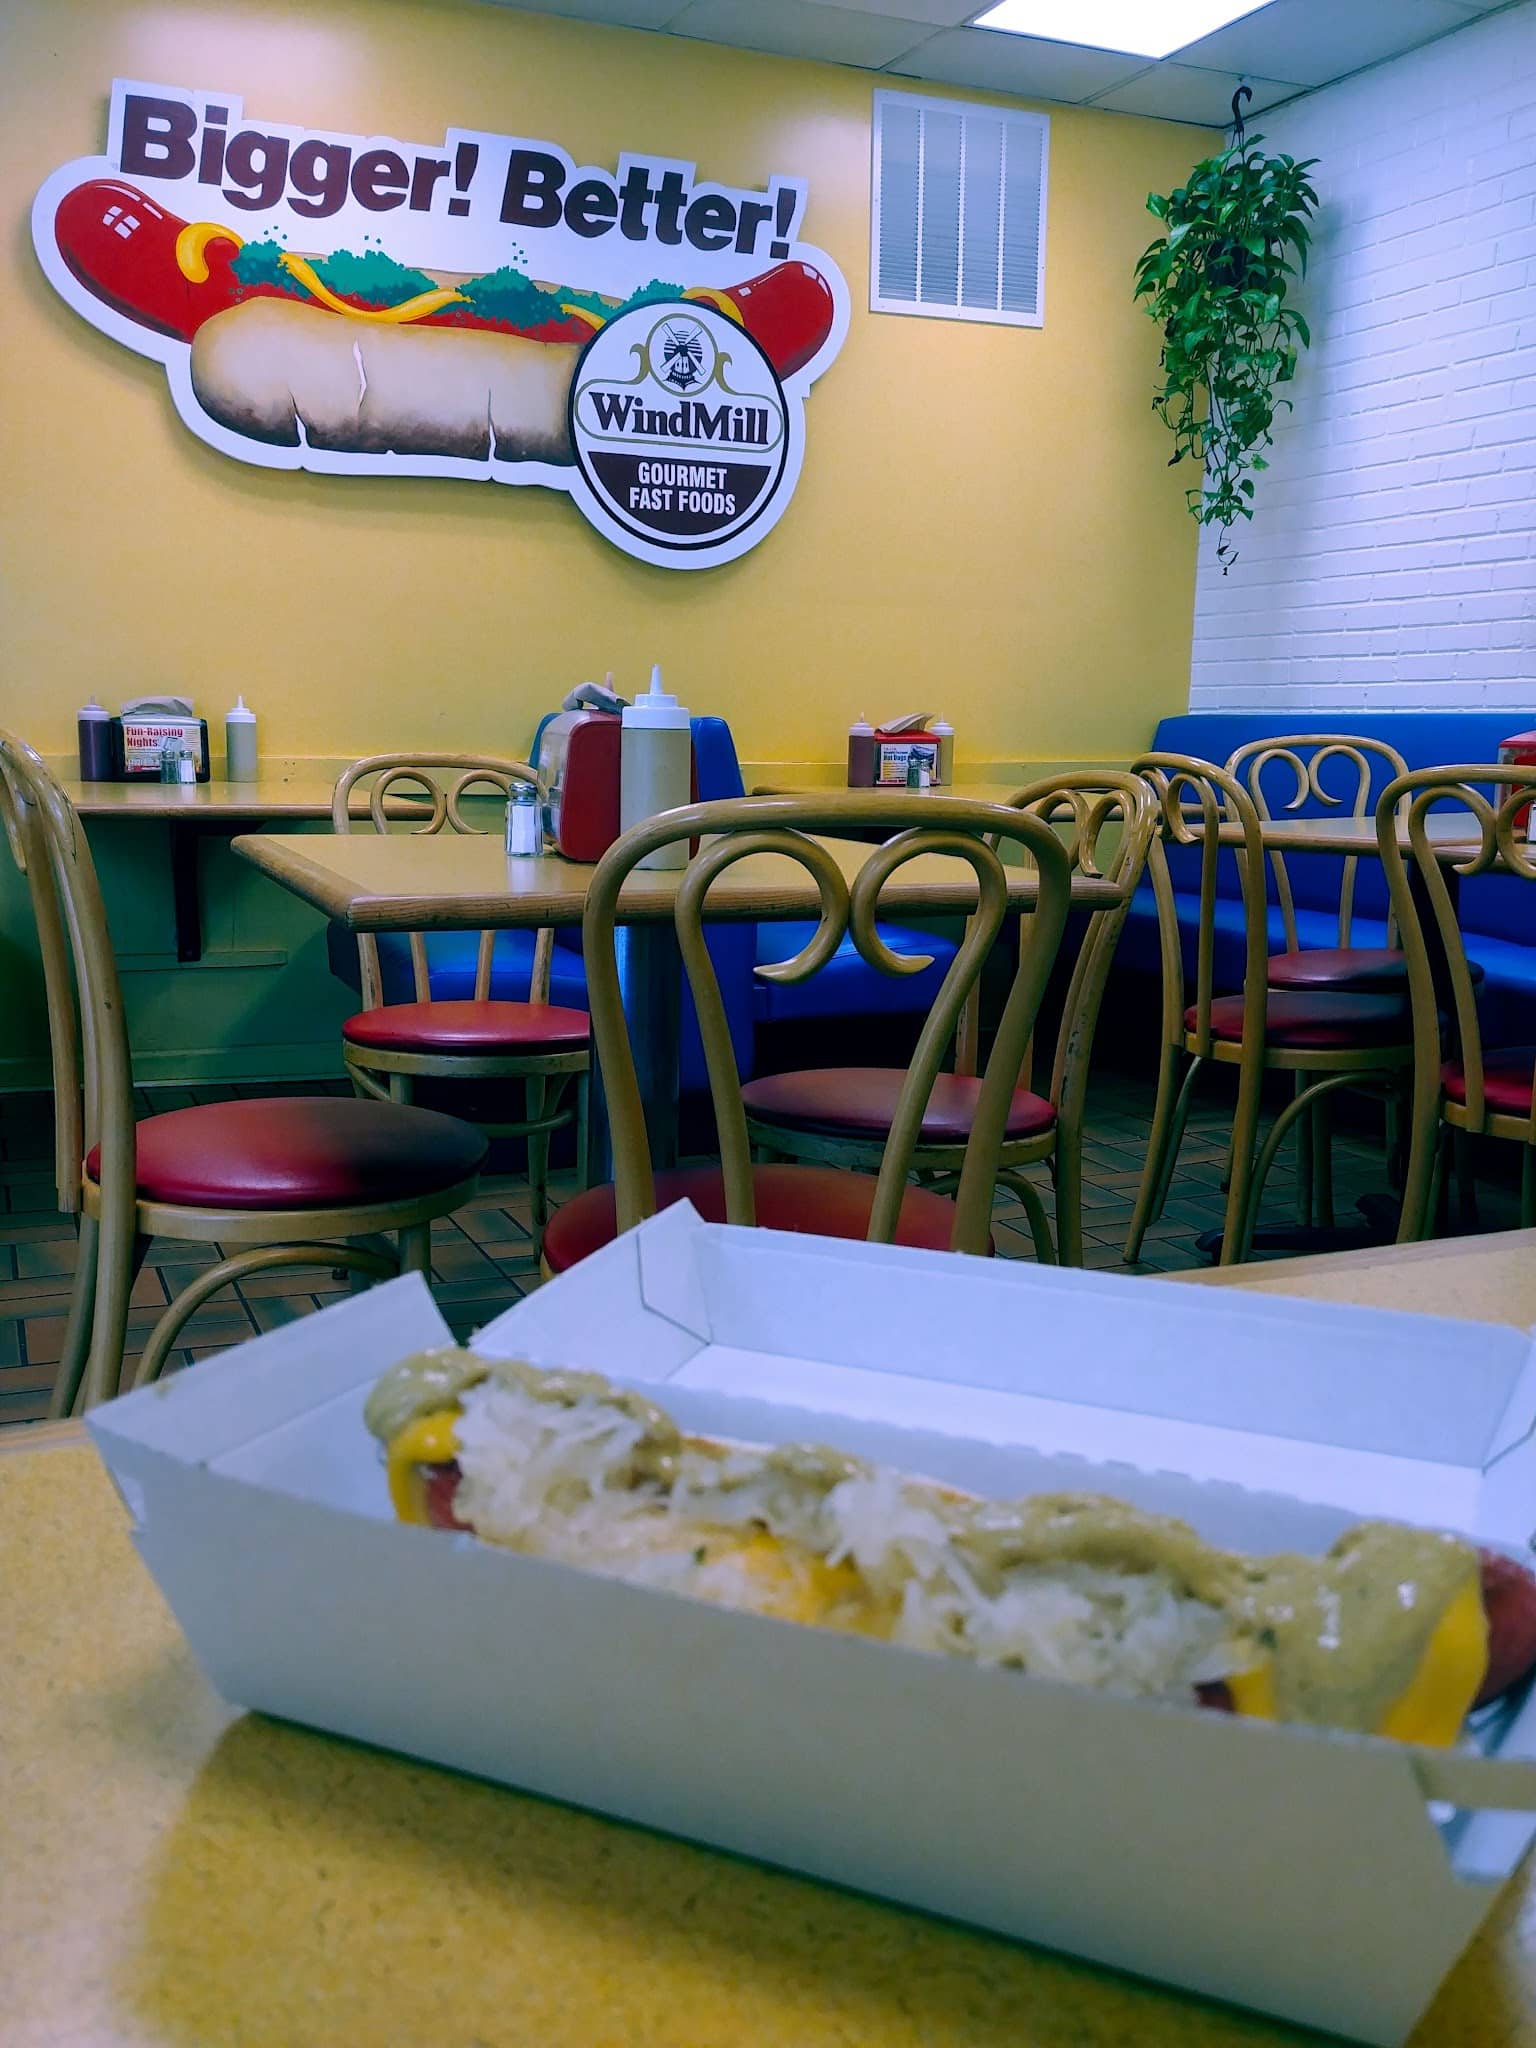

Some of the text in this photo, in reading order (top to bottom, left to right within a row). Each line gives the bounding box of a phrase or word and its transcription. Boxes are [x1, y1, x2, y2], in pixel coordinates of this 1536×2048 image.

[119, 94, 797, 259] Bigger! Better!
[588, 391, 769, 445] WindMill
[638, 462, 728, 490] GOURMET
[629, 487, 736, 515] FAST FOODS
[126, 726, 183, 737] Fun-Raising
[127, 737, 158, 748] Nights
